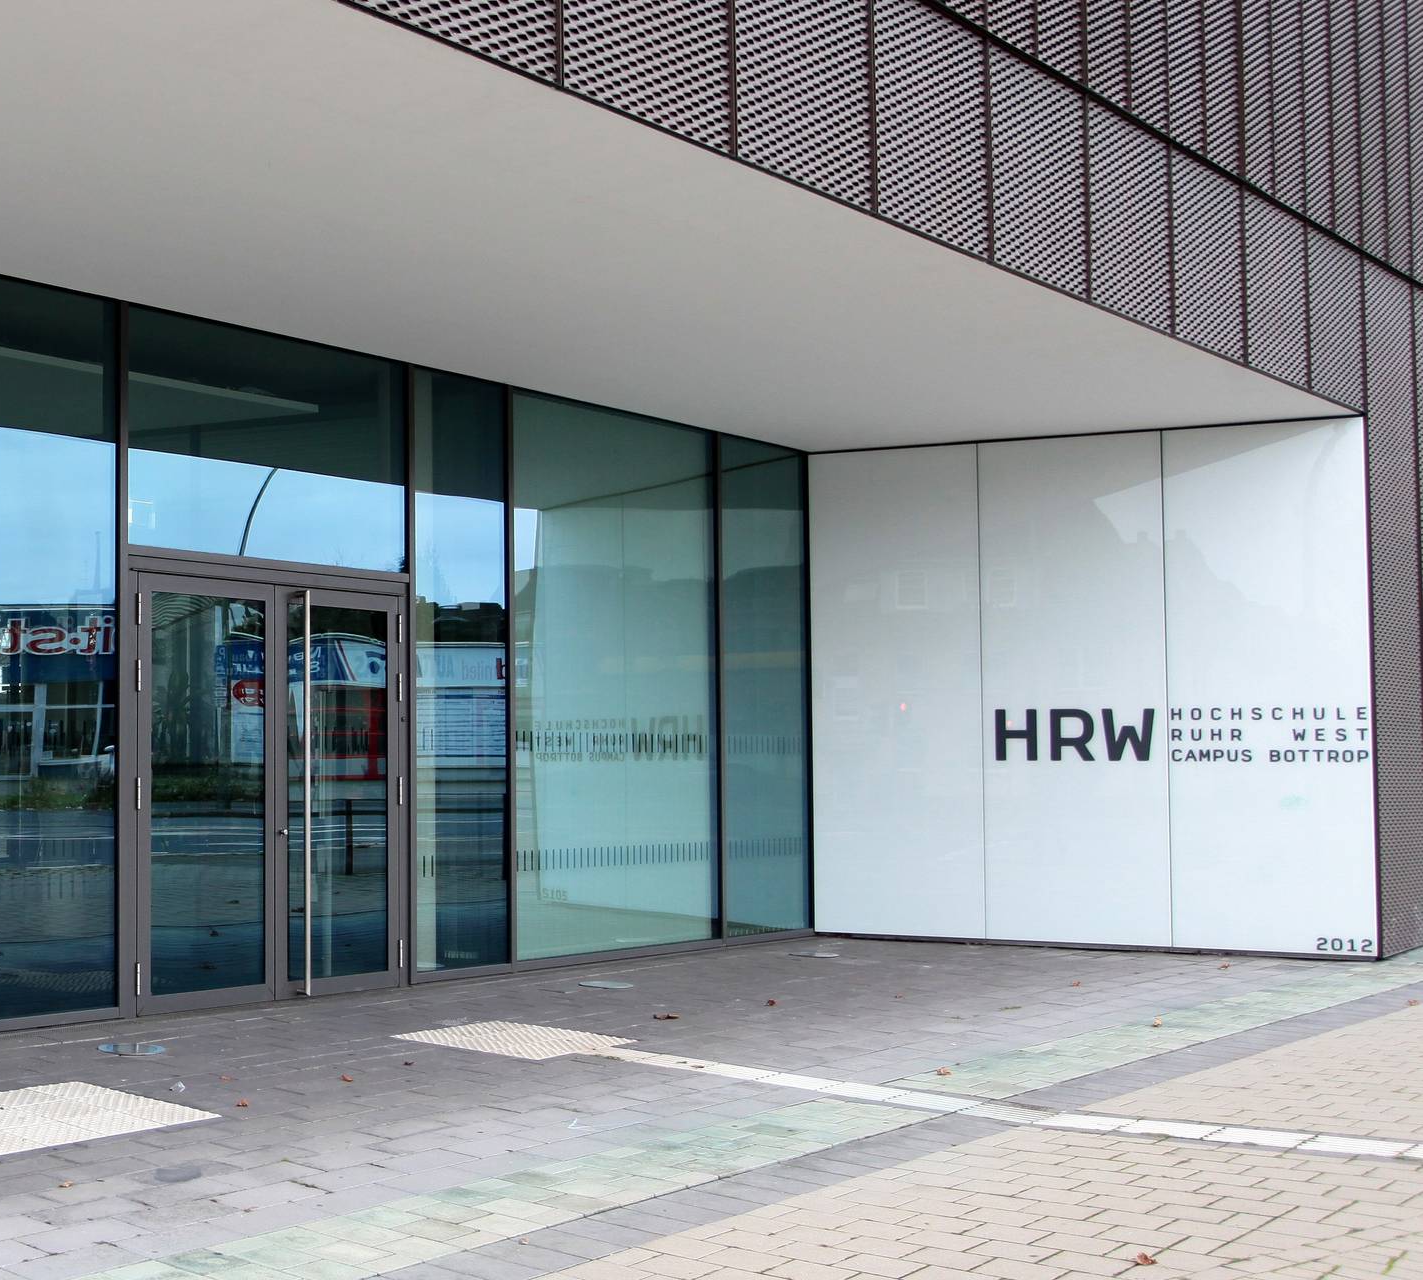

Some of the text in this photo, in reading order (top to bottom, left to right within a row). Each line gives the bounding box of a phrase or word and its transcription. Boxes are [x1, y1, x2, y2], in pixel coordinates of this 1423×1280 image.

[995, 707, 1368, 761] HRW HOCHSCHULE
[1170, 728, 1368, 741] RUHR WEST
[1171, 749, 1369, 763] CAMPUS BOTTROP
[1316, 937, 1373, 953] 2012
